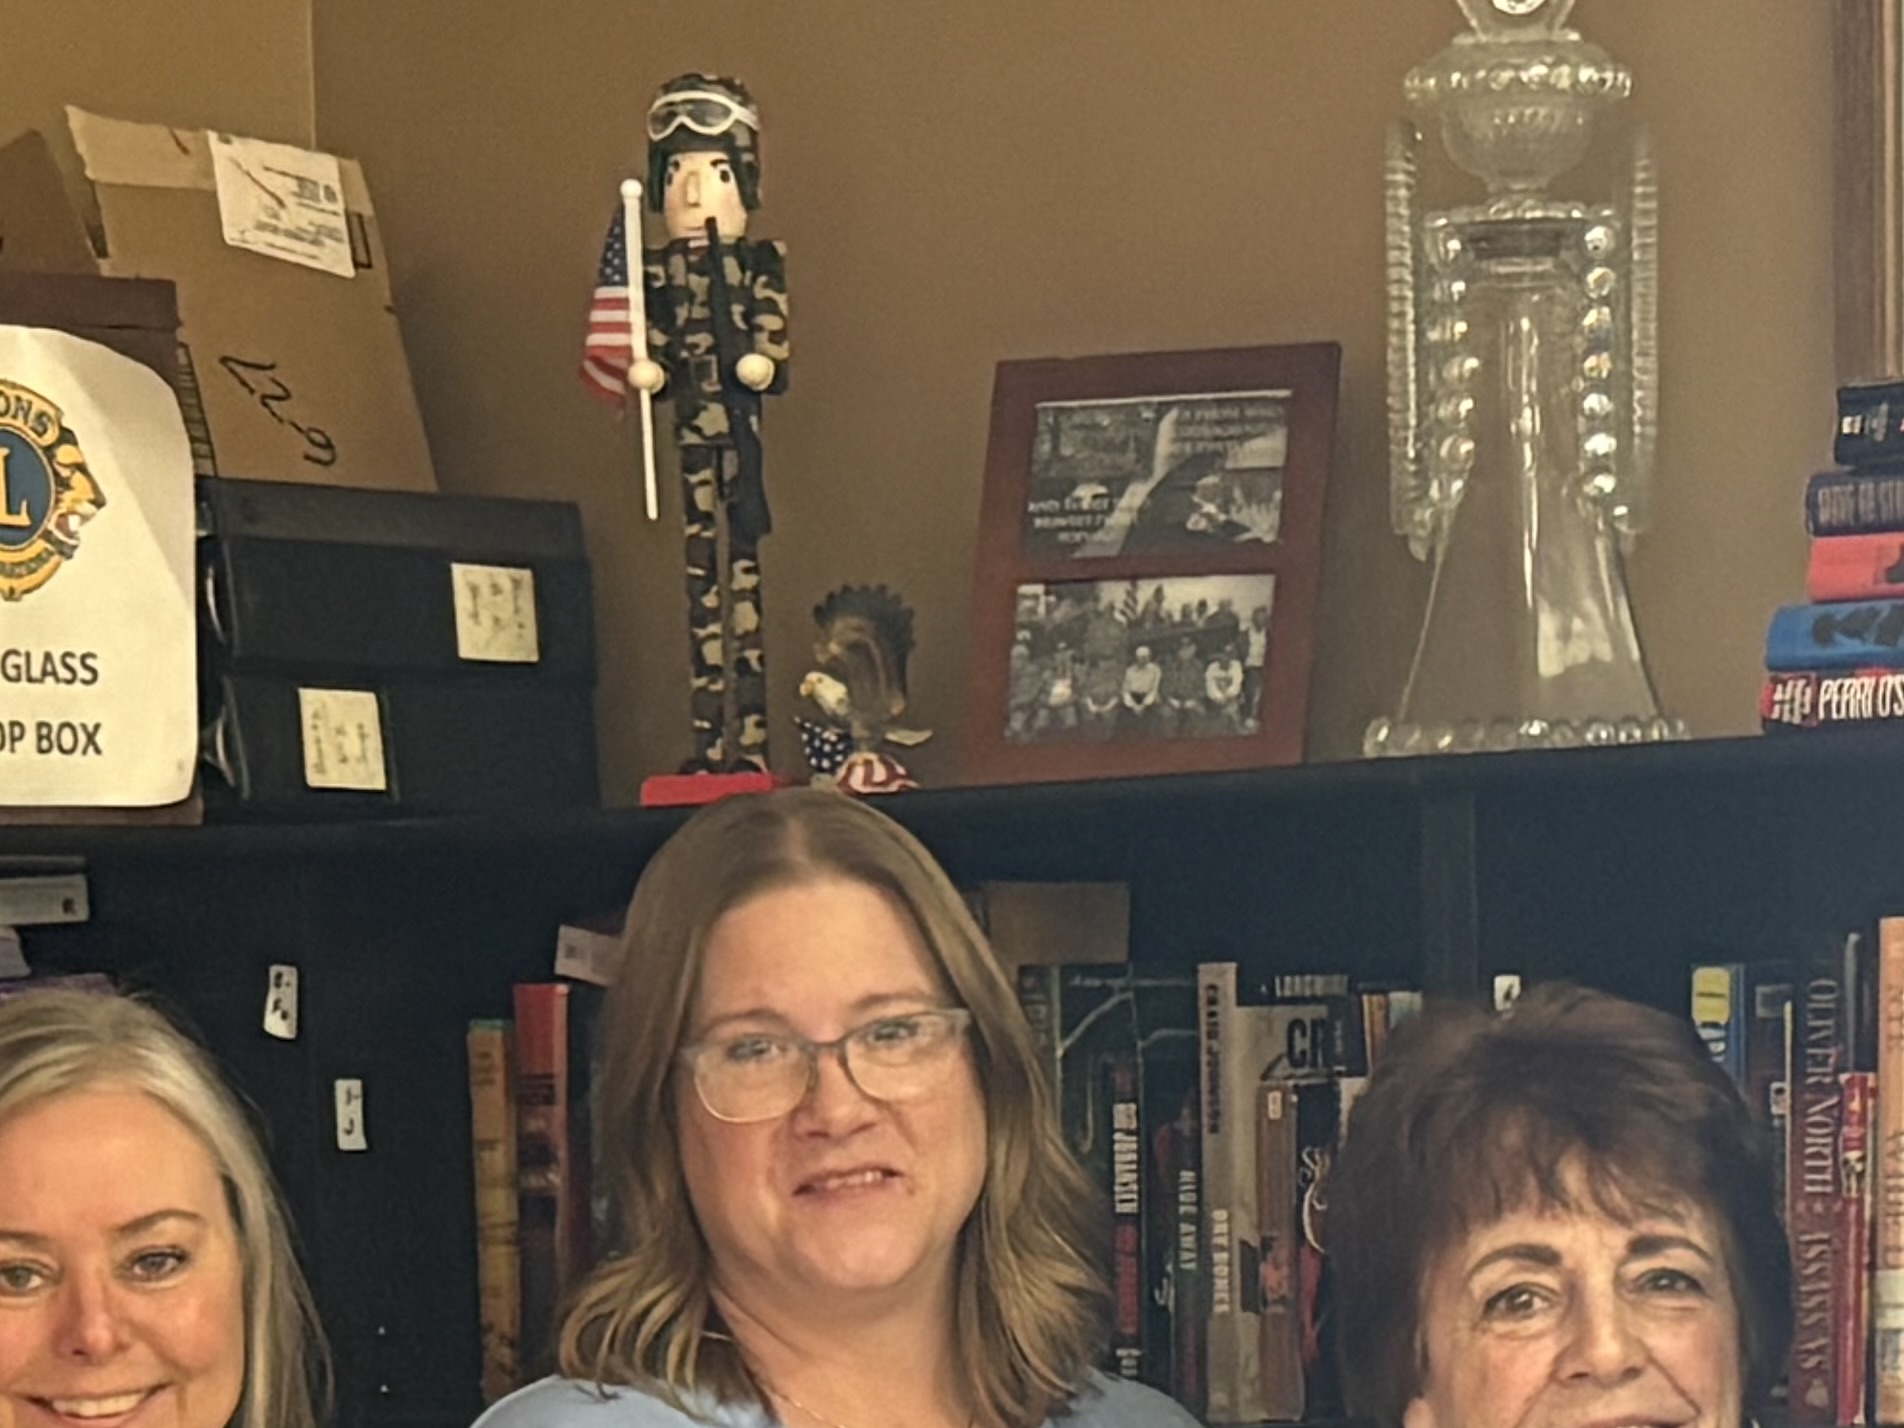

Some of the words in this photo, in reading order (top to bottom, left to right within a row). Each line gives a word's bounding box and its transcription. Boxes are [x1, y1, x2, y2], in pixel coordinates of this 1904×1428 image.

[0, 646, 100, 686] GLASS
[1818, 675, 1873, 721] PERRI
[36, 719, 104, 757] BOX
[1809, 977, 1843, 1084] OLIVER
[1802, 1093, 1842, 1195] NORTH
[1178, 1221, 1199, 1272] AWAY
